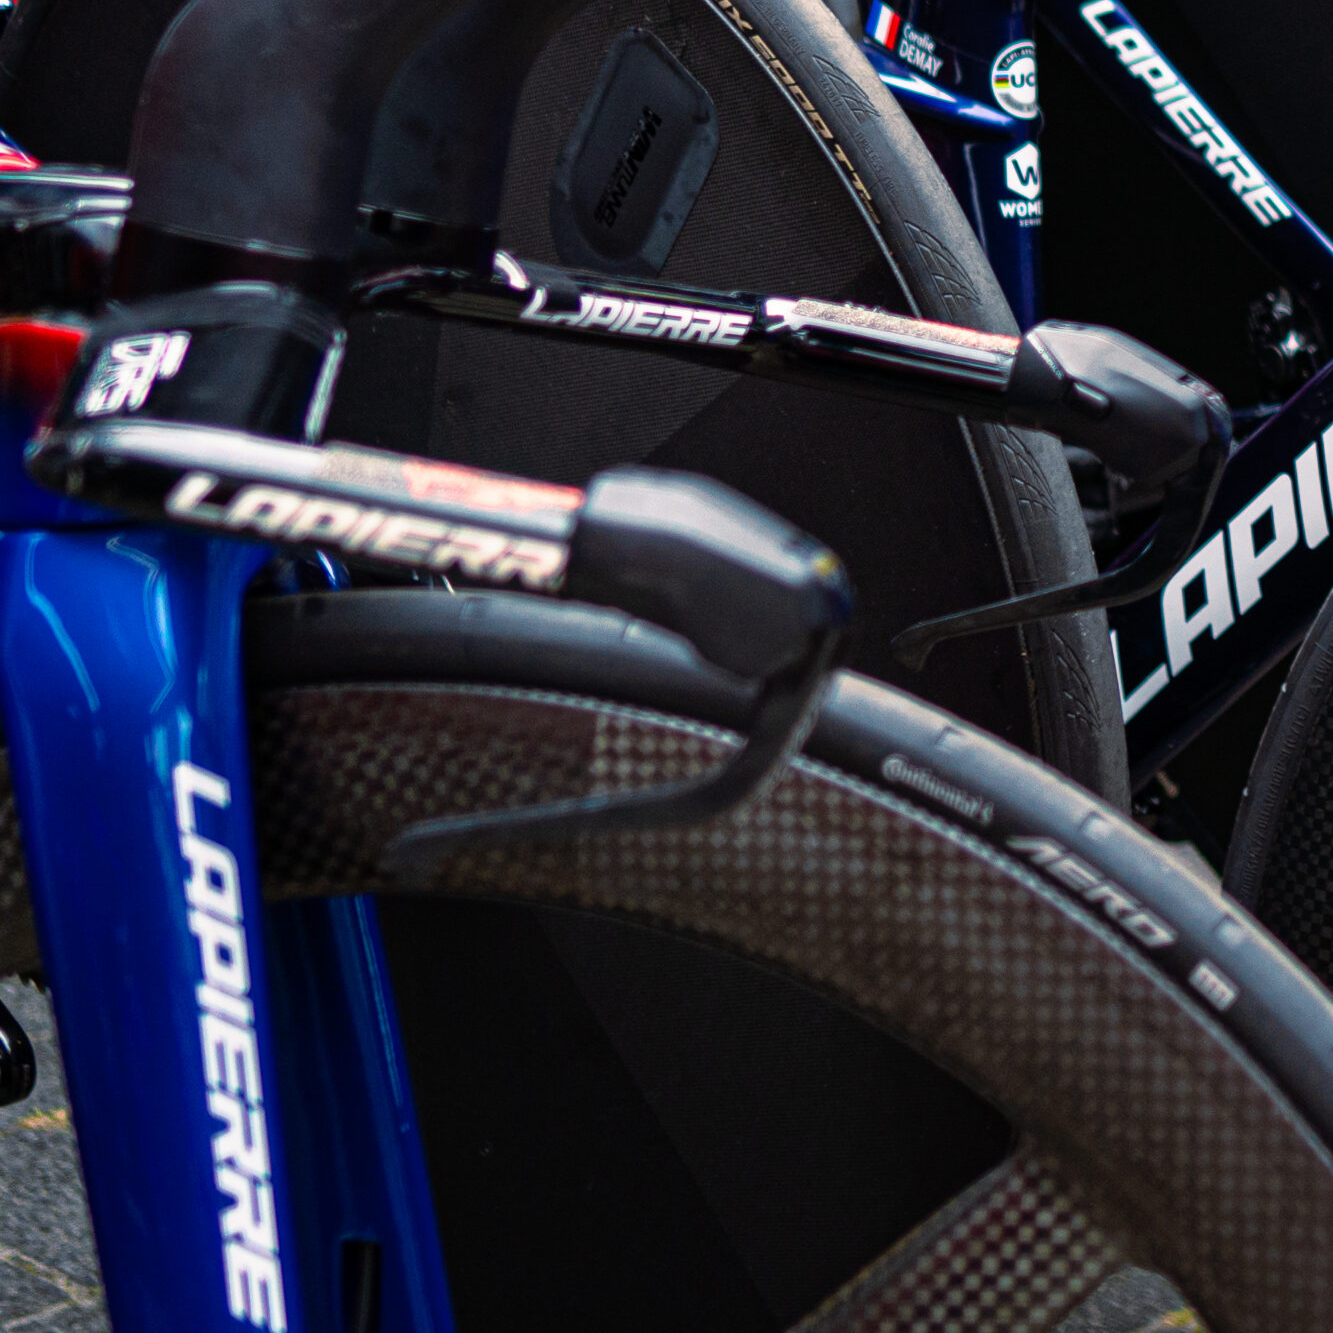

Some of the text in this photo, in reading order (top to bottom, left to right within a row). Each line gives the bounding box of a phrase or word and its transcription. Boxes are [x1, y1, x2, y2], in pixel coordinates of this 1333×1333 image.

[898, 39, 943, 78] DEMAY
[1004, 833, 1179, 949] AERO
[173, 761, 286, 1333] LAPIERRE
